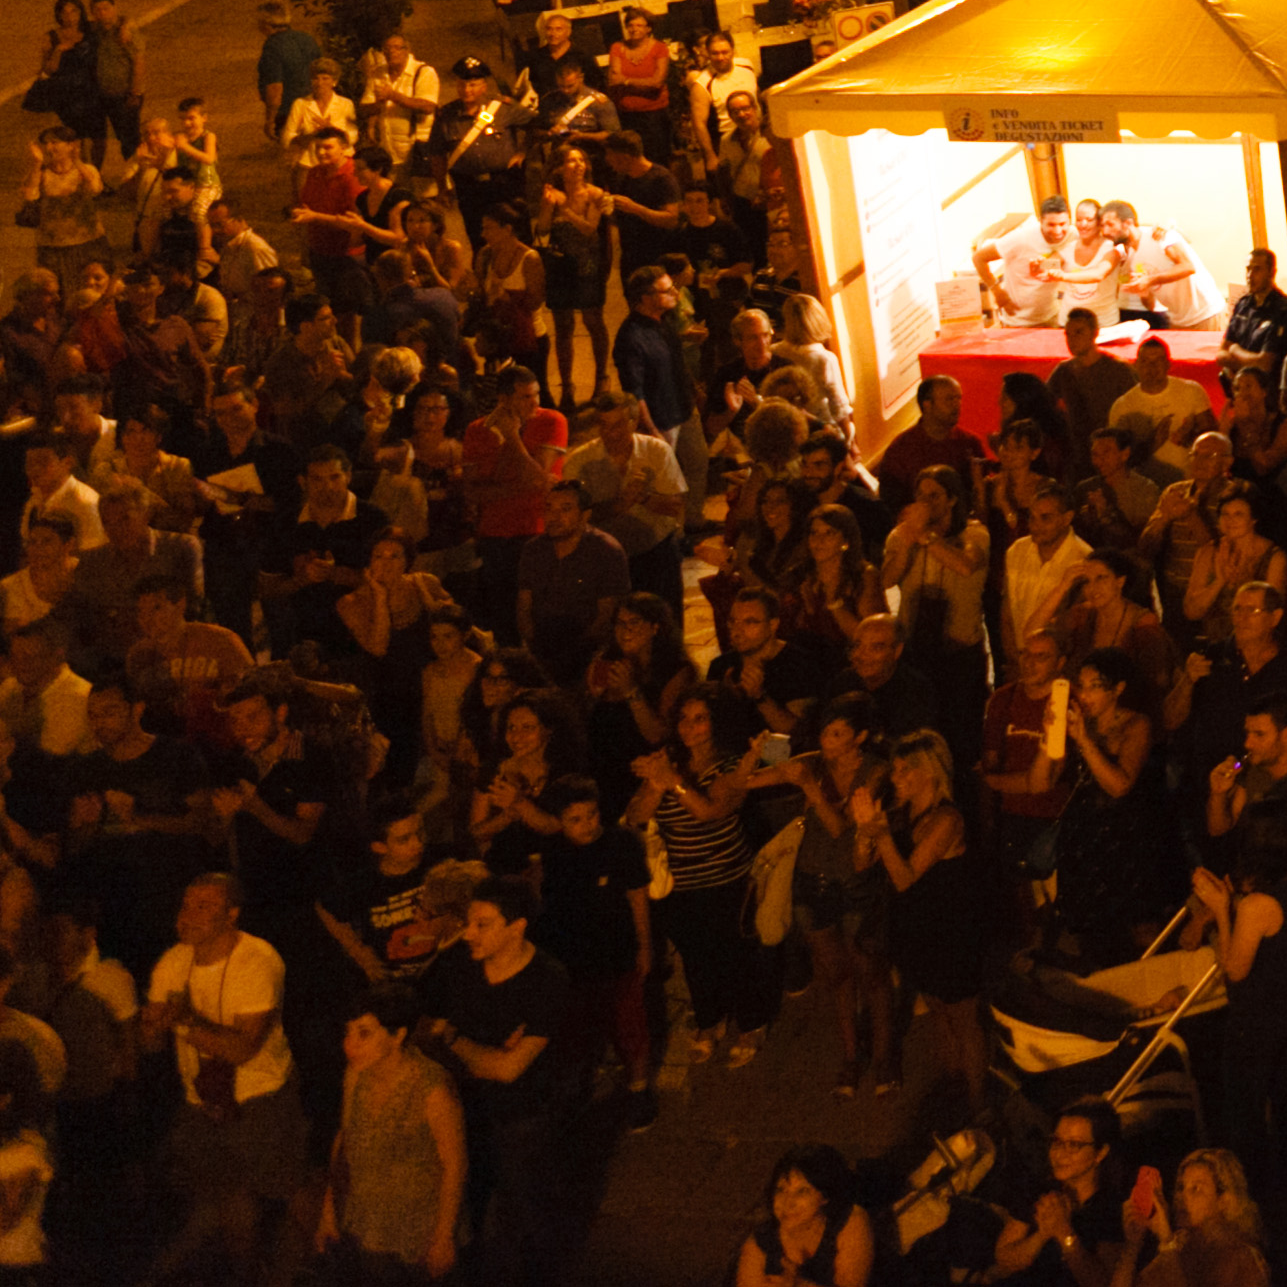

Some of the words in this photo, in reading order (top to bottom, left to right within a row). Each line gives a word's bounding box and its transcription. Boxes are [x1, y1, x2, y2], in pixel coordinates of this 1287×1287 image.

[991, 109, 1018, 119] INFO
[1003, 121, 1056, 131] VENDITA
[1060, 121, 1104, 131] TICKET
[995, 132, 1084, 141] DEGUSTAZIONI
